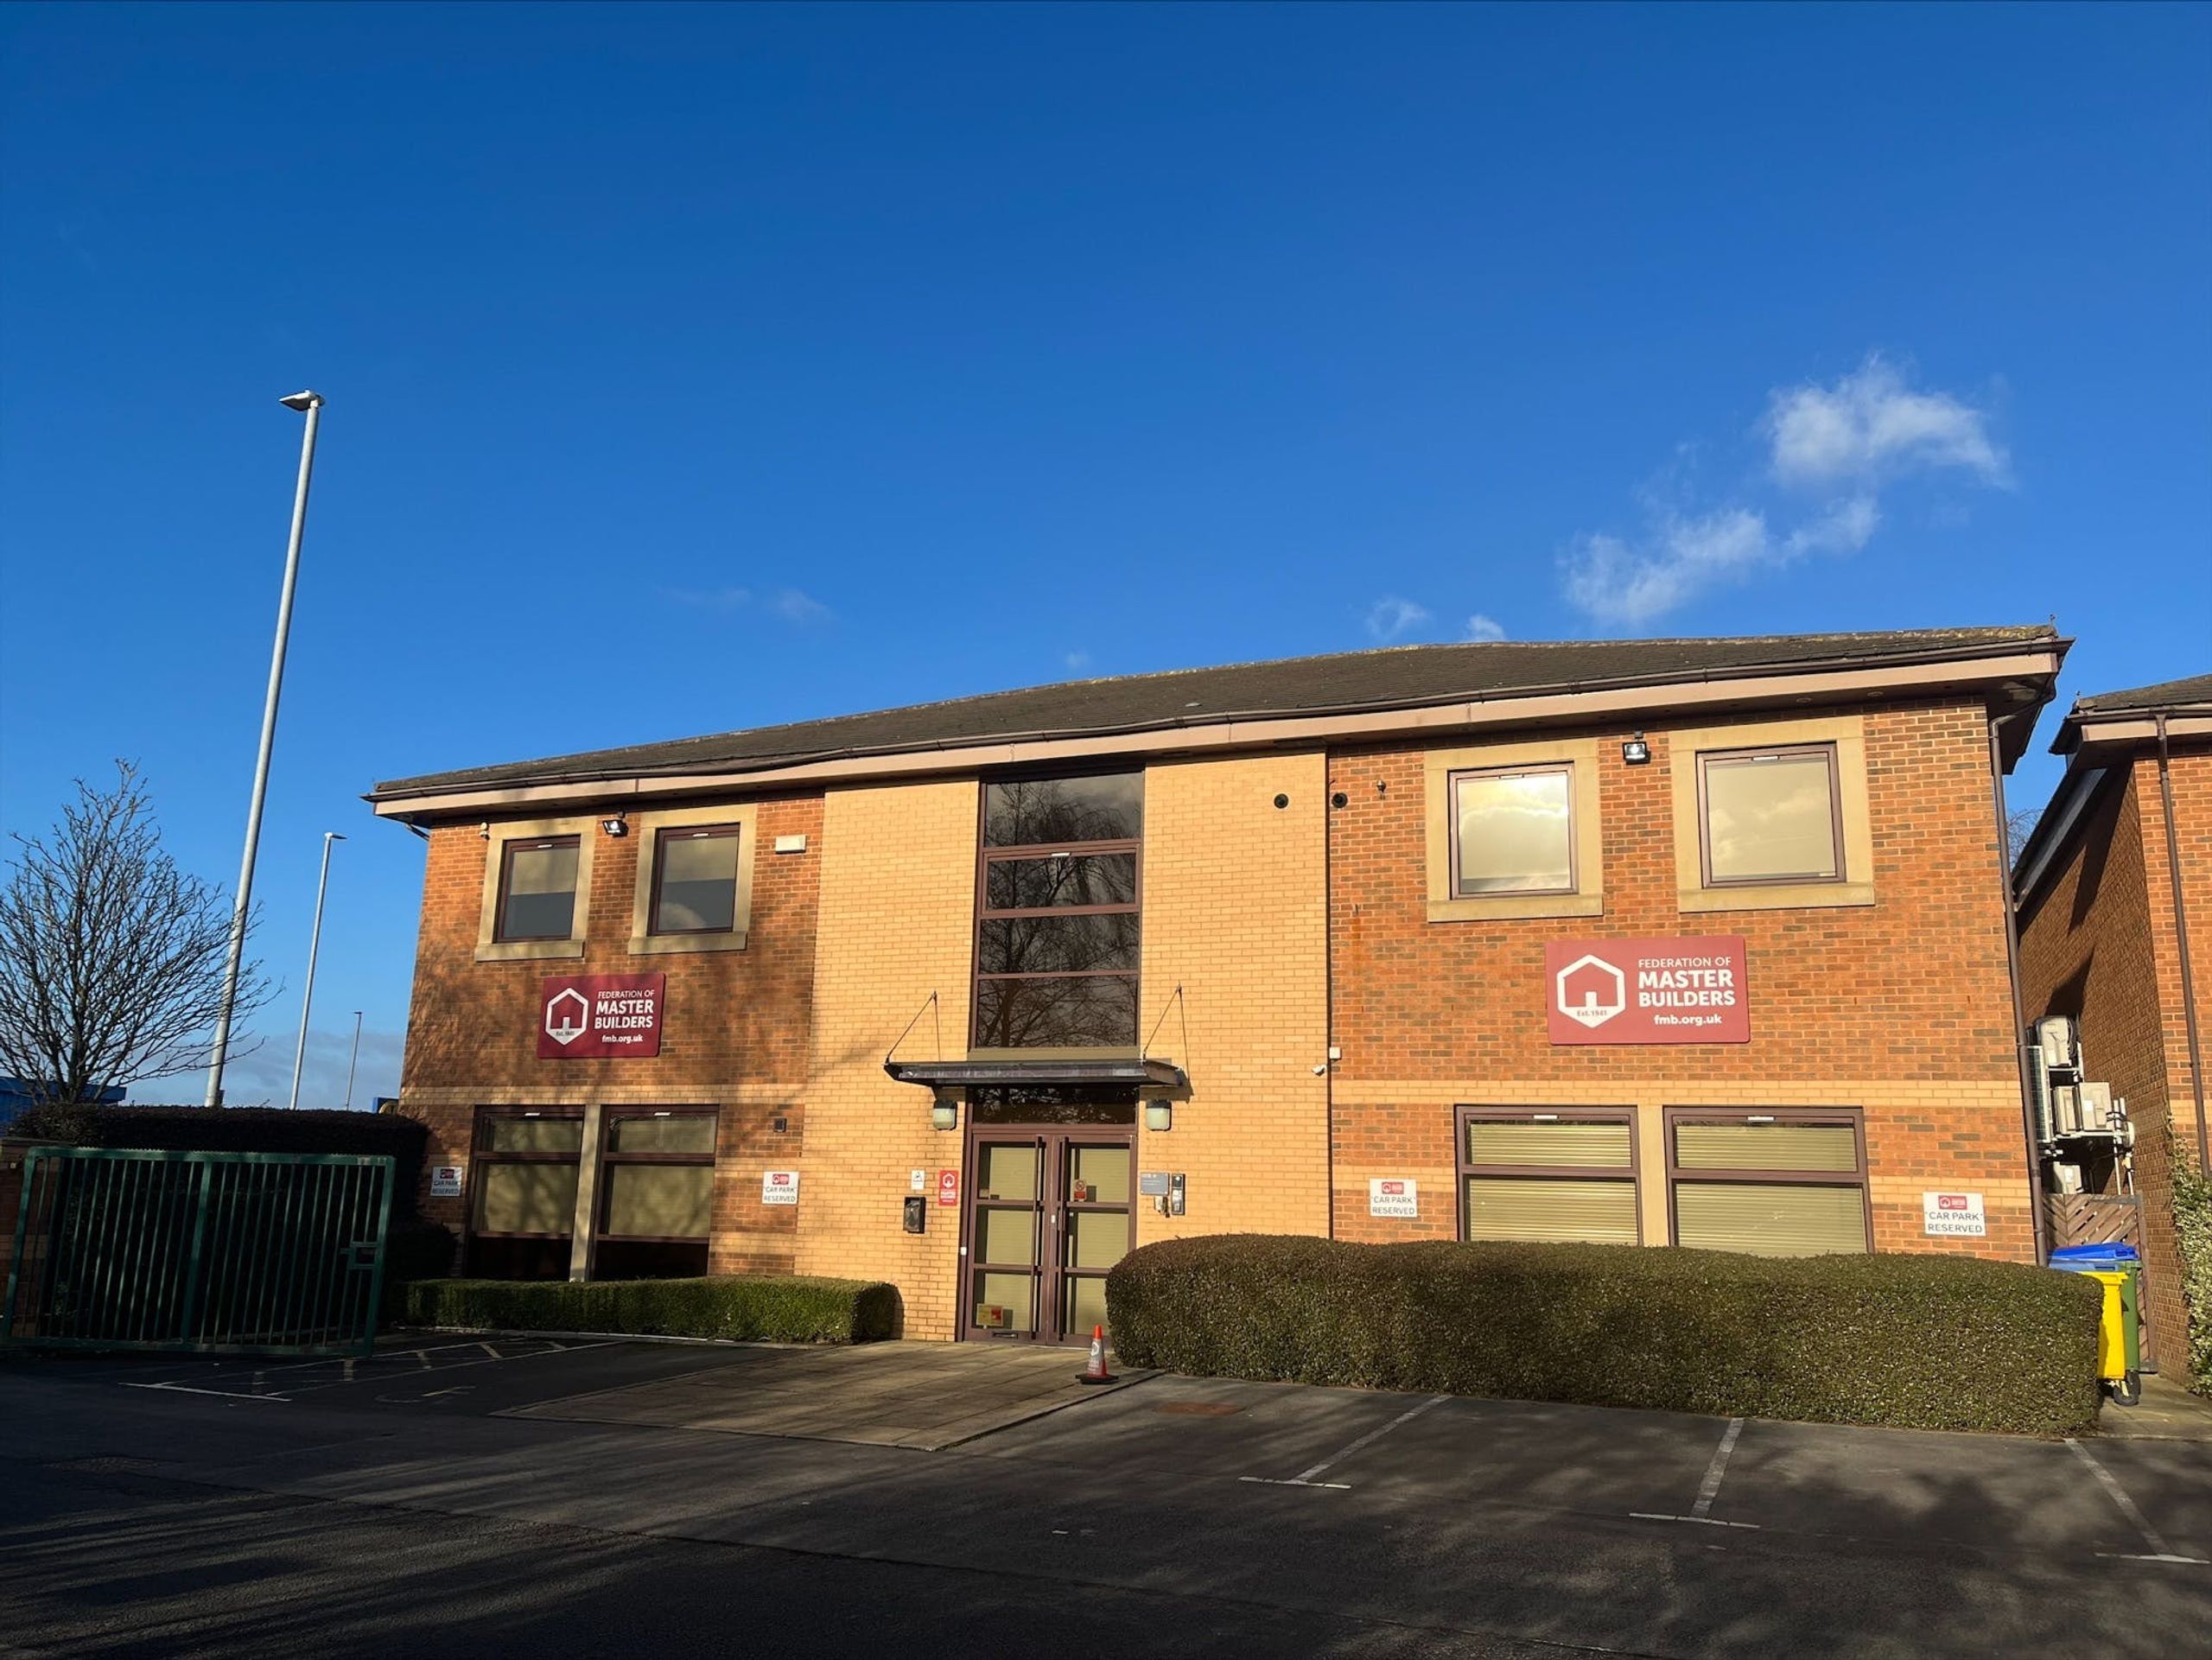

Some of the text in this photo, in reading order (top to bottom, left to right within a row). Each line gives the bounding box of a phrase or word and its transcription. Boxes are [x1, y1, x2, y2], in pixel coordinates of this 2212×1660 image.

[1638, 957, 1732, 968] FEDERATION OF
[1638, 970, 1734, 989] MASTER
[598, 990, 642, 999] FEDERATION
[1638, 990, 1736, 1008] BUILDERS
[595, 1000, 654, 1015] MASTER
[594, 1015, 653, 1029] BUILDERS
[1655, 1014, 1722, 1027] fmb.org.uk
[601, 1034, 643, 1044] fmb.org.uk
[1373, 1195, 1390, 1204] CAR
[1372, 1206, 1415, 1215] RESERVED
[1929, 1212, 1980, 1221] CAR PARK
[1928, 1224, 1983, 1233] RESERVED
